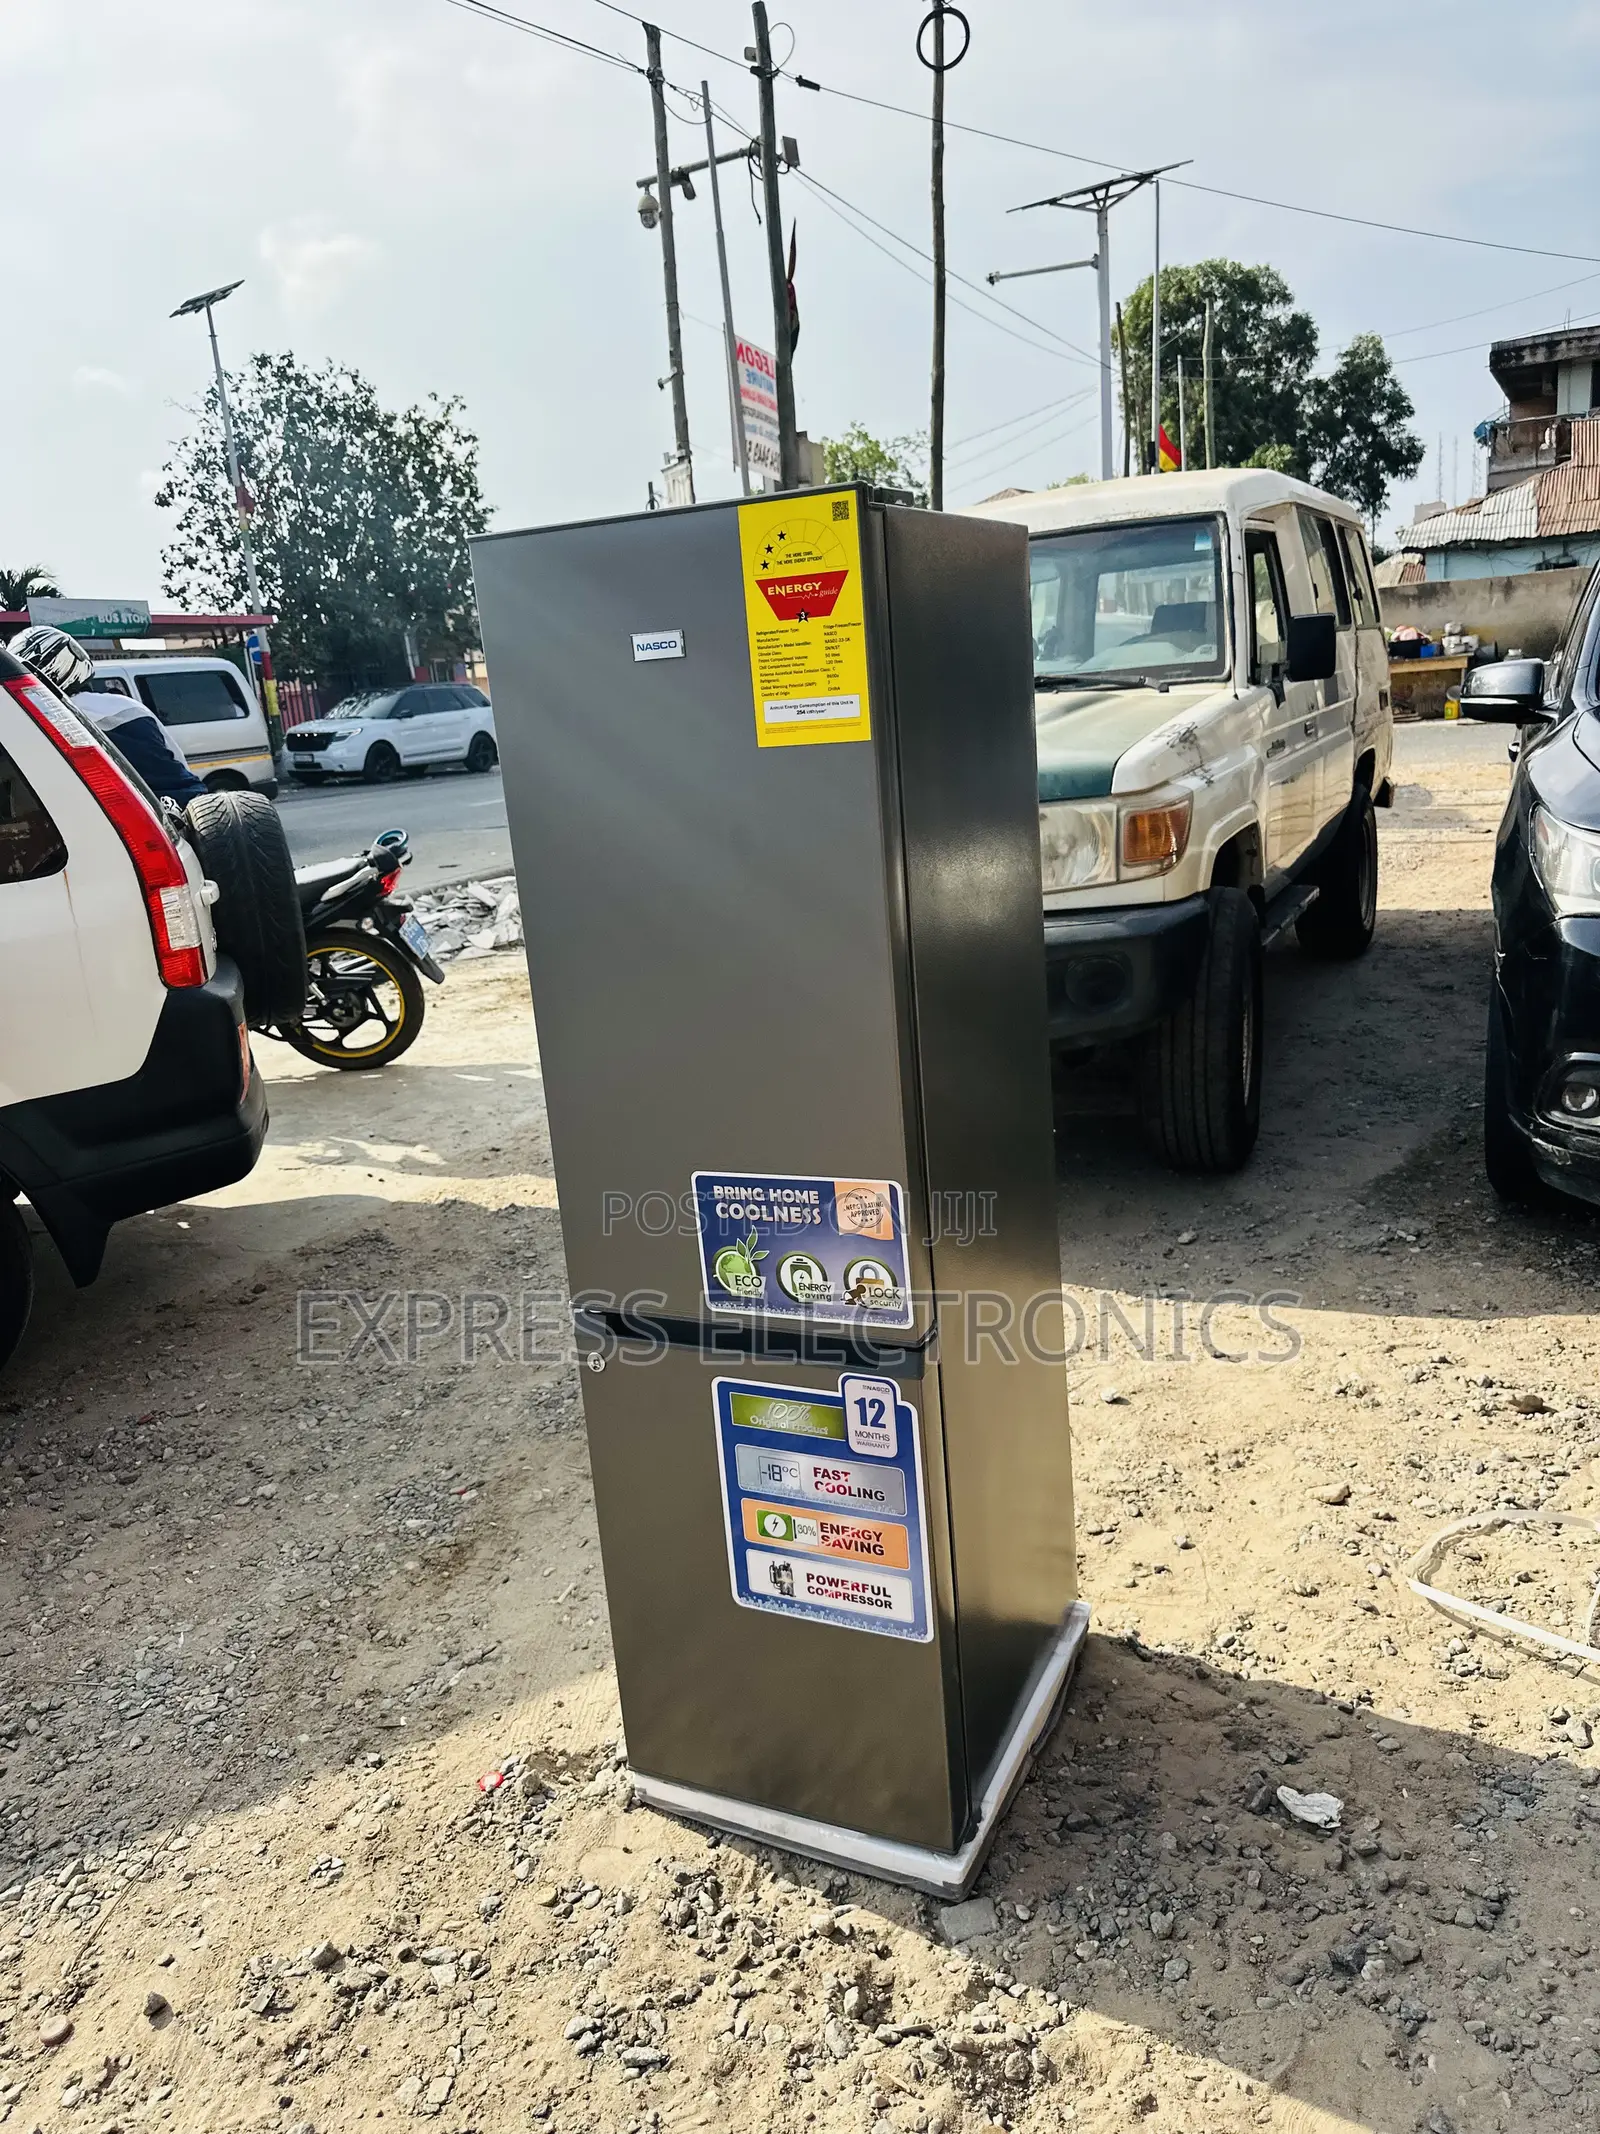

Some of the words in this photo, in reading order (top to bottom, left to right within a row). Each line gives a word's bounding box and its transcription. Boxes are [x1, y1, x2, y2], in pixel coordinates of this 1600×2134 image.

[767, 581, 822, 597] ENERGY
[819, 586, 838, 598] guide
[98, 612, 119, 624] BUS
[800, 611, 806, 619] 3
[636, 640, 677, 651] NASCO
[712, 1185, 765, 1202] BRING
[769, 1188, 820, 1205] HOME
[715, 1202, 822, 1225] COOLNESS
[850, 1208, 880, 1217] APPROVED
[734, 1274, 762, 1288] ECO
[798, 1282, 832, 1293] ENERGY
[736, 1286, 763, 1298] friendly
[799, 1291, 832, 1303] saving
[868, 1286, 901, 1299] LOCK
[869, 1298, 902, 1309] security
[866, 1385, 890, 1393] NASCO
[767, 1401, 811, 1422] 100%
[854, 1397, 887, 1429] 12
[750, 1415, 789, 1430] Original
[789, 1423, 829, 1435] Product
[854, 1430, 890, 1441] MONTHS
[856, 1440, 890, 1450] WARRANTY
[813, 1466, 851, 1483] FAST
[814, 1481, 886, 1501] COOLING
[797, 1523, 817, 1538] 30%
[820, 1521, 883, 1542] ENERGY
[821, 1535, 885, 1556] SAVING
[806, 1572, 892, 1598] POWERFUL
[807, 1585, 893, 1610] COMPRESSOR
